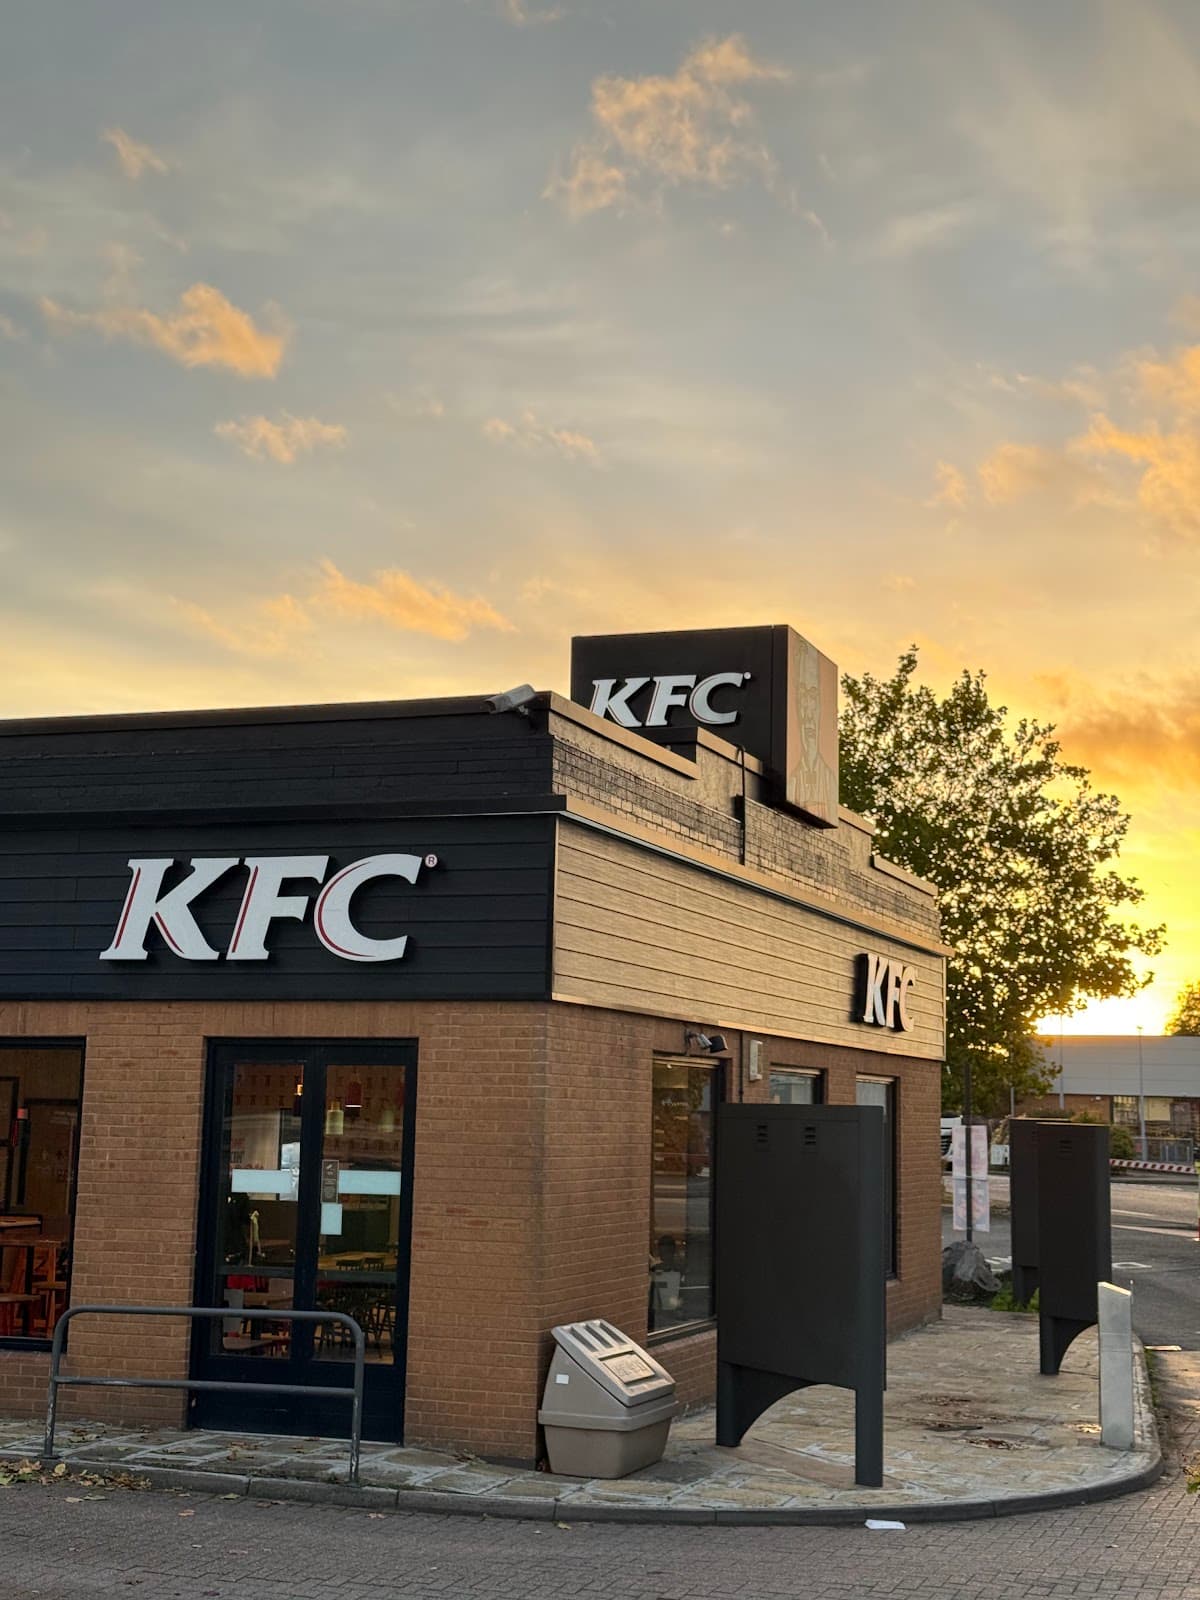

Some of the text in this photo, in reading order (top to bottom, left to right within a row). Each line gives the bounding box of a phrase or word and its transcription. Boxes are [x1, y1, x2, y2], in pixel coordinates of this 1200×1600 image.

[589, 672, 744, 728] KFC
[99, 853, 423, 962] KFC
[863, 953, 916, 1032] KFC
